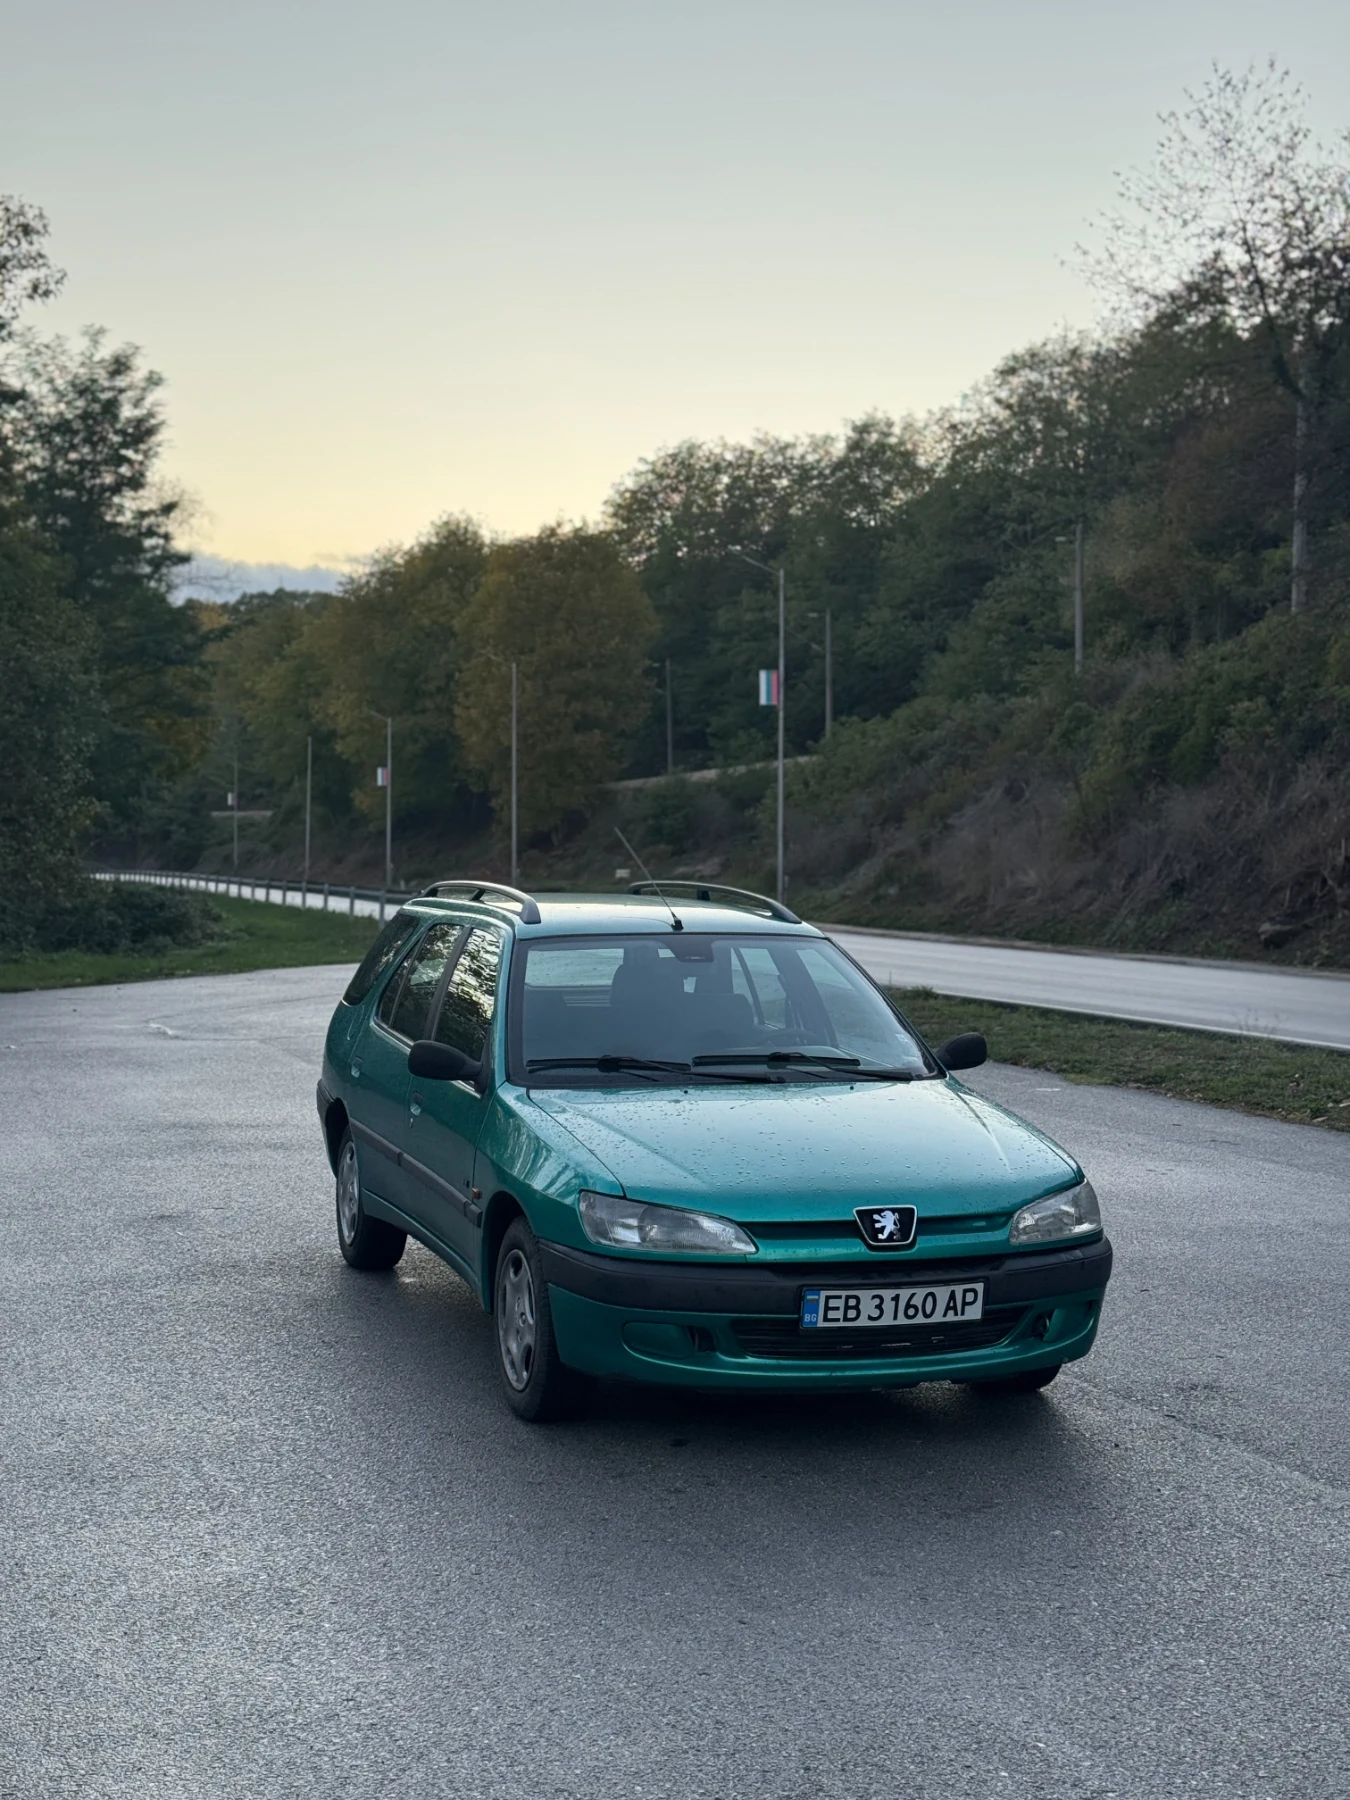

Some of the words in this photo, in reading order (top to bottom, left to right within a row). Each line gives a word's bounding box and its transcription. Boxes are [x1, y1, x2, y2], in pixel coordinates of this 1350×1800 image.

[822, 1294, 861, 1323] EB
[867, 1291, 937, 1322] 3160
[943, 1287, 979, 1318] AP
[804, 1313, 817, 1322] BG
